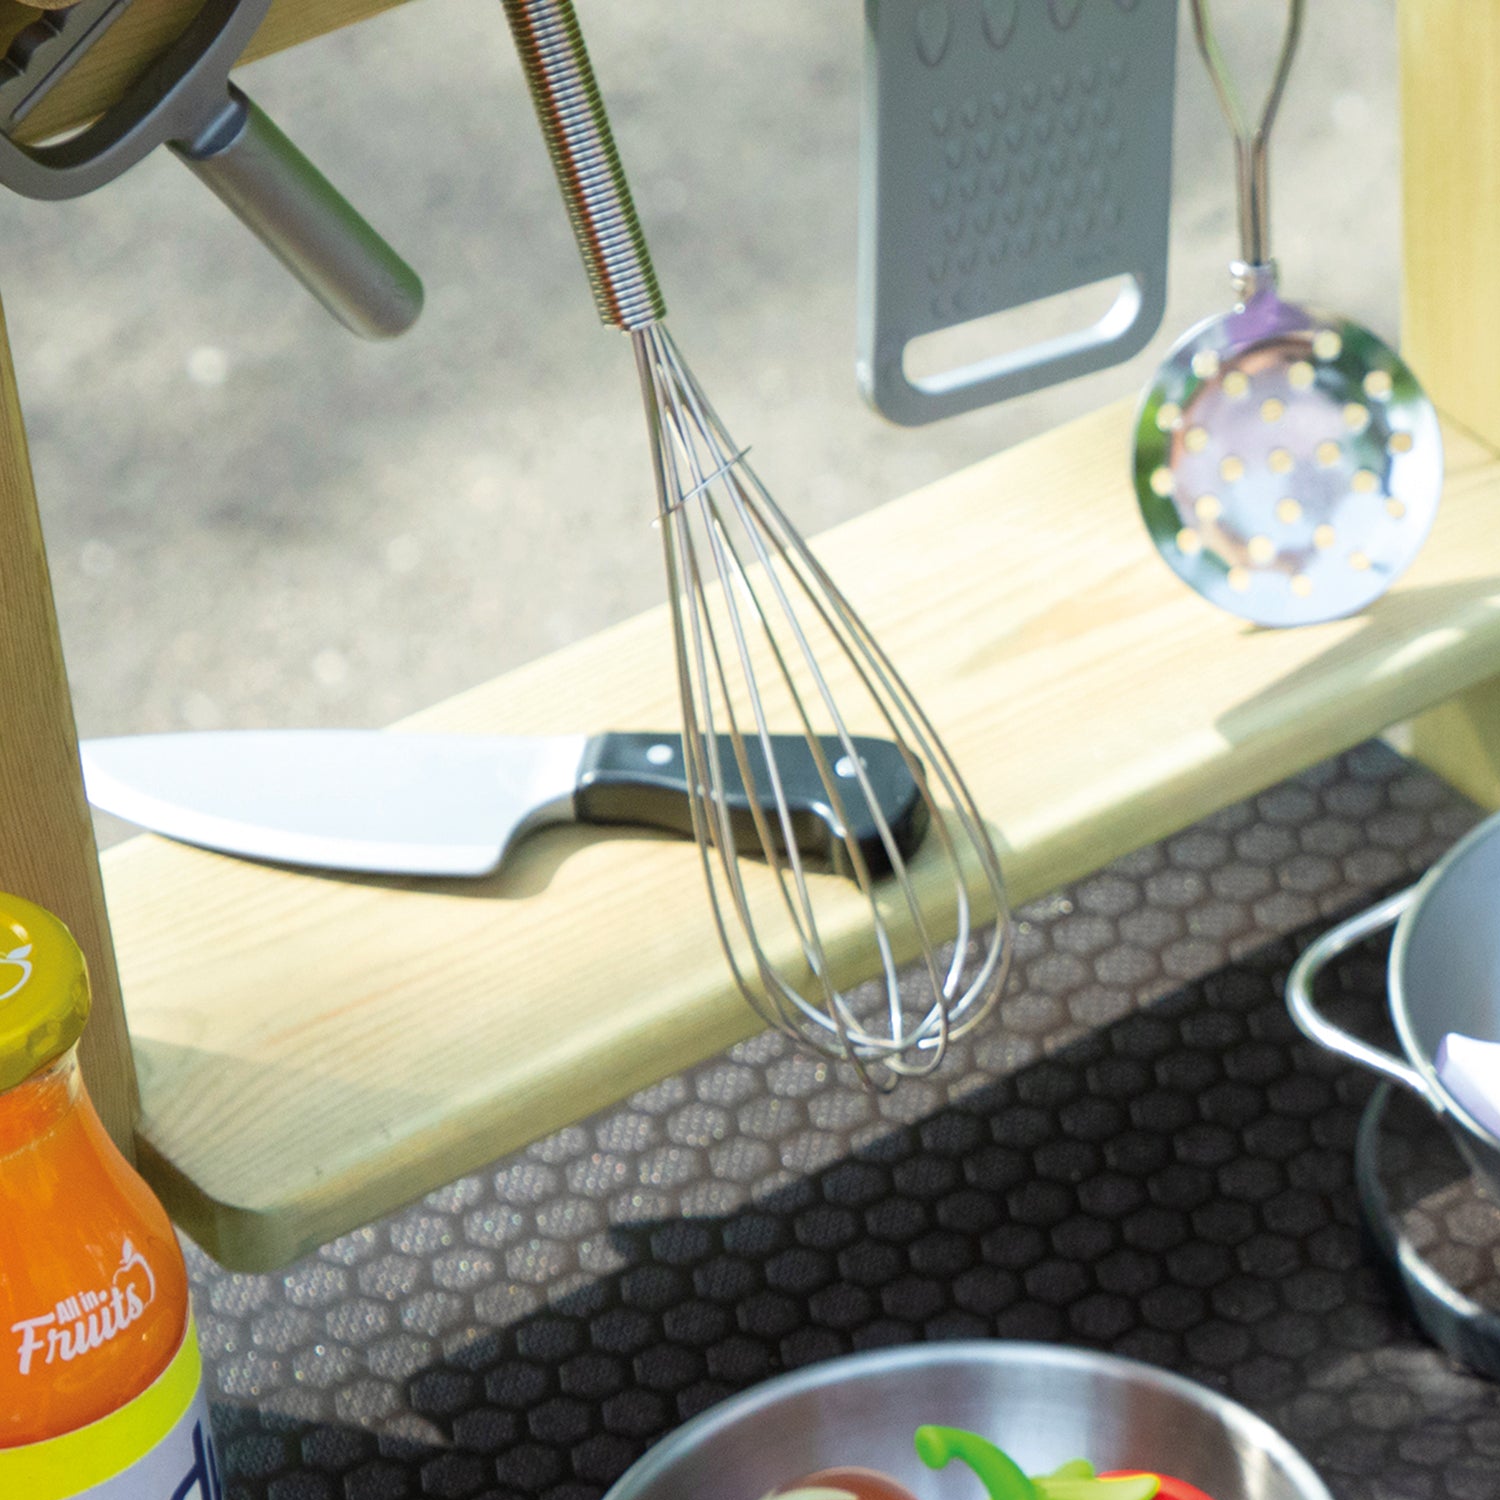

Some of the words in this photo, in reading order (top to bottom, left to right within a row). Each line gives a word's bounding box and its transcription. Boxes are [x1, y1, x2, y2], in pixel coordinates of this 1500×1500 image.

[10, 1282, 144, 1376] Fruits
[55, 1296, 82, 1325] All
[78, 1290, 100, 1312] in
